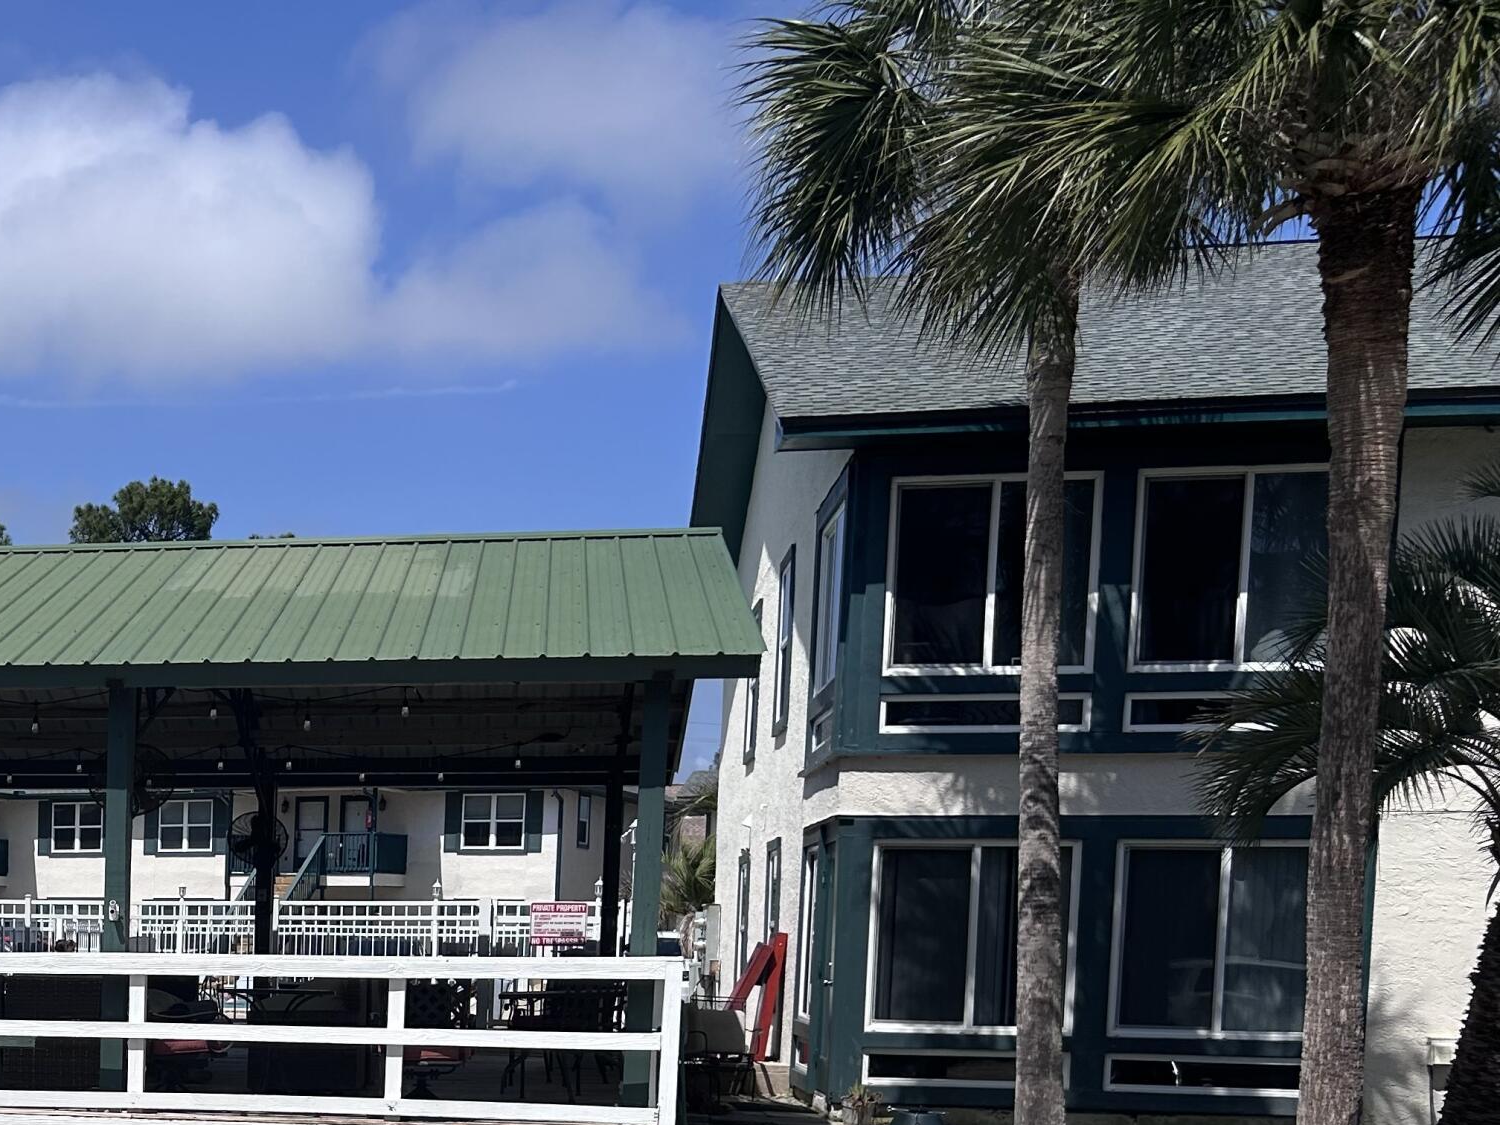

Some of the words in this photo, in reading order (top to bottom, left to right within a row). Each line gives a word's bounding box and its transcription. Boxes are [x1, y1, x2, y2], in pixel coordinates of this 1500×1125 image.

[532, 904, 555, 912] PRIVATE
[556, 904, 586, 912] PROPERTY
[531, 937, 540, 945] NO
